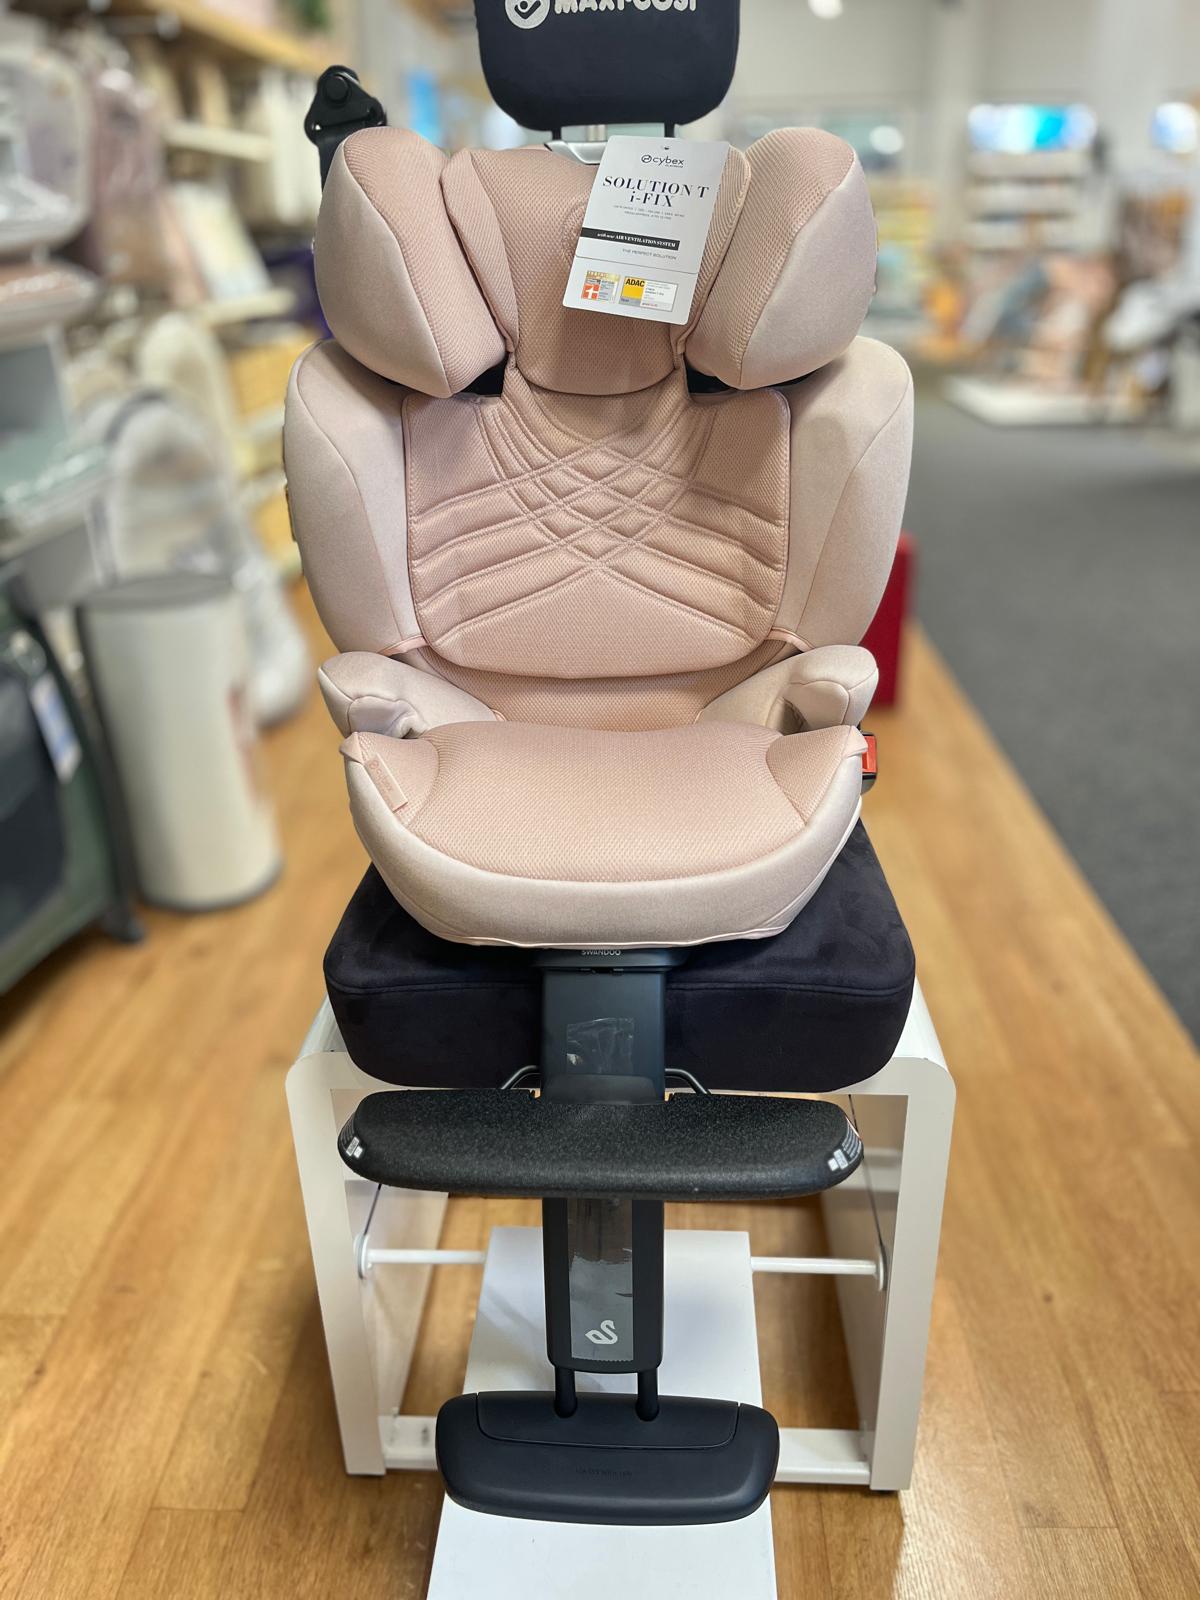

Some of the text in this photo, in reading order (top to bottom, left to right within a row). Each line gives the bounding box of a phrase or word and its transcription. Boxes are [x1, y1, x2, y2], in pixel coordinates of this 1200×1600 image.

[652, 156, 685, 166] cybex
[602, 176, 710, 198] SOLUTION T
[630, 190, 675, 207] i-FIX
[625, 278, 645, 287] ADAC
